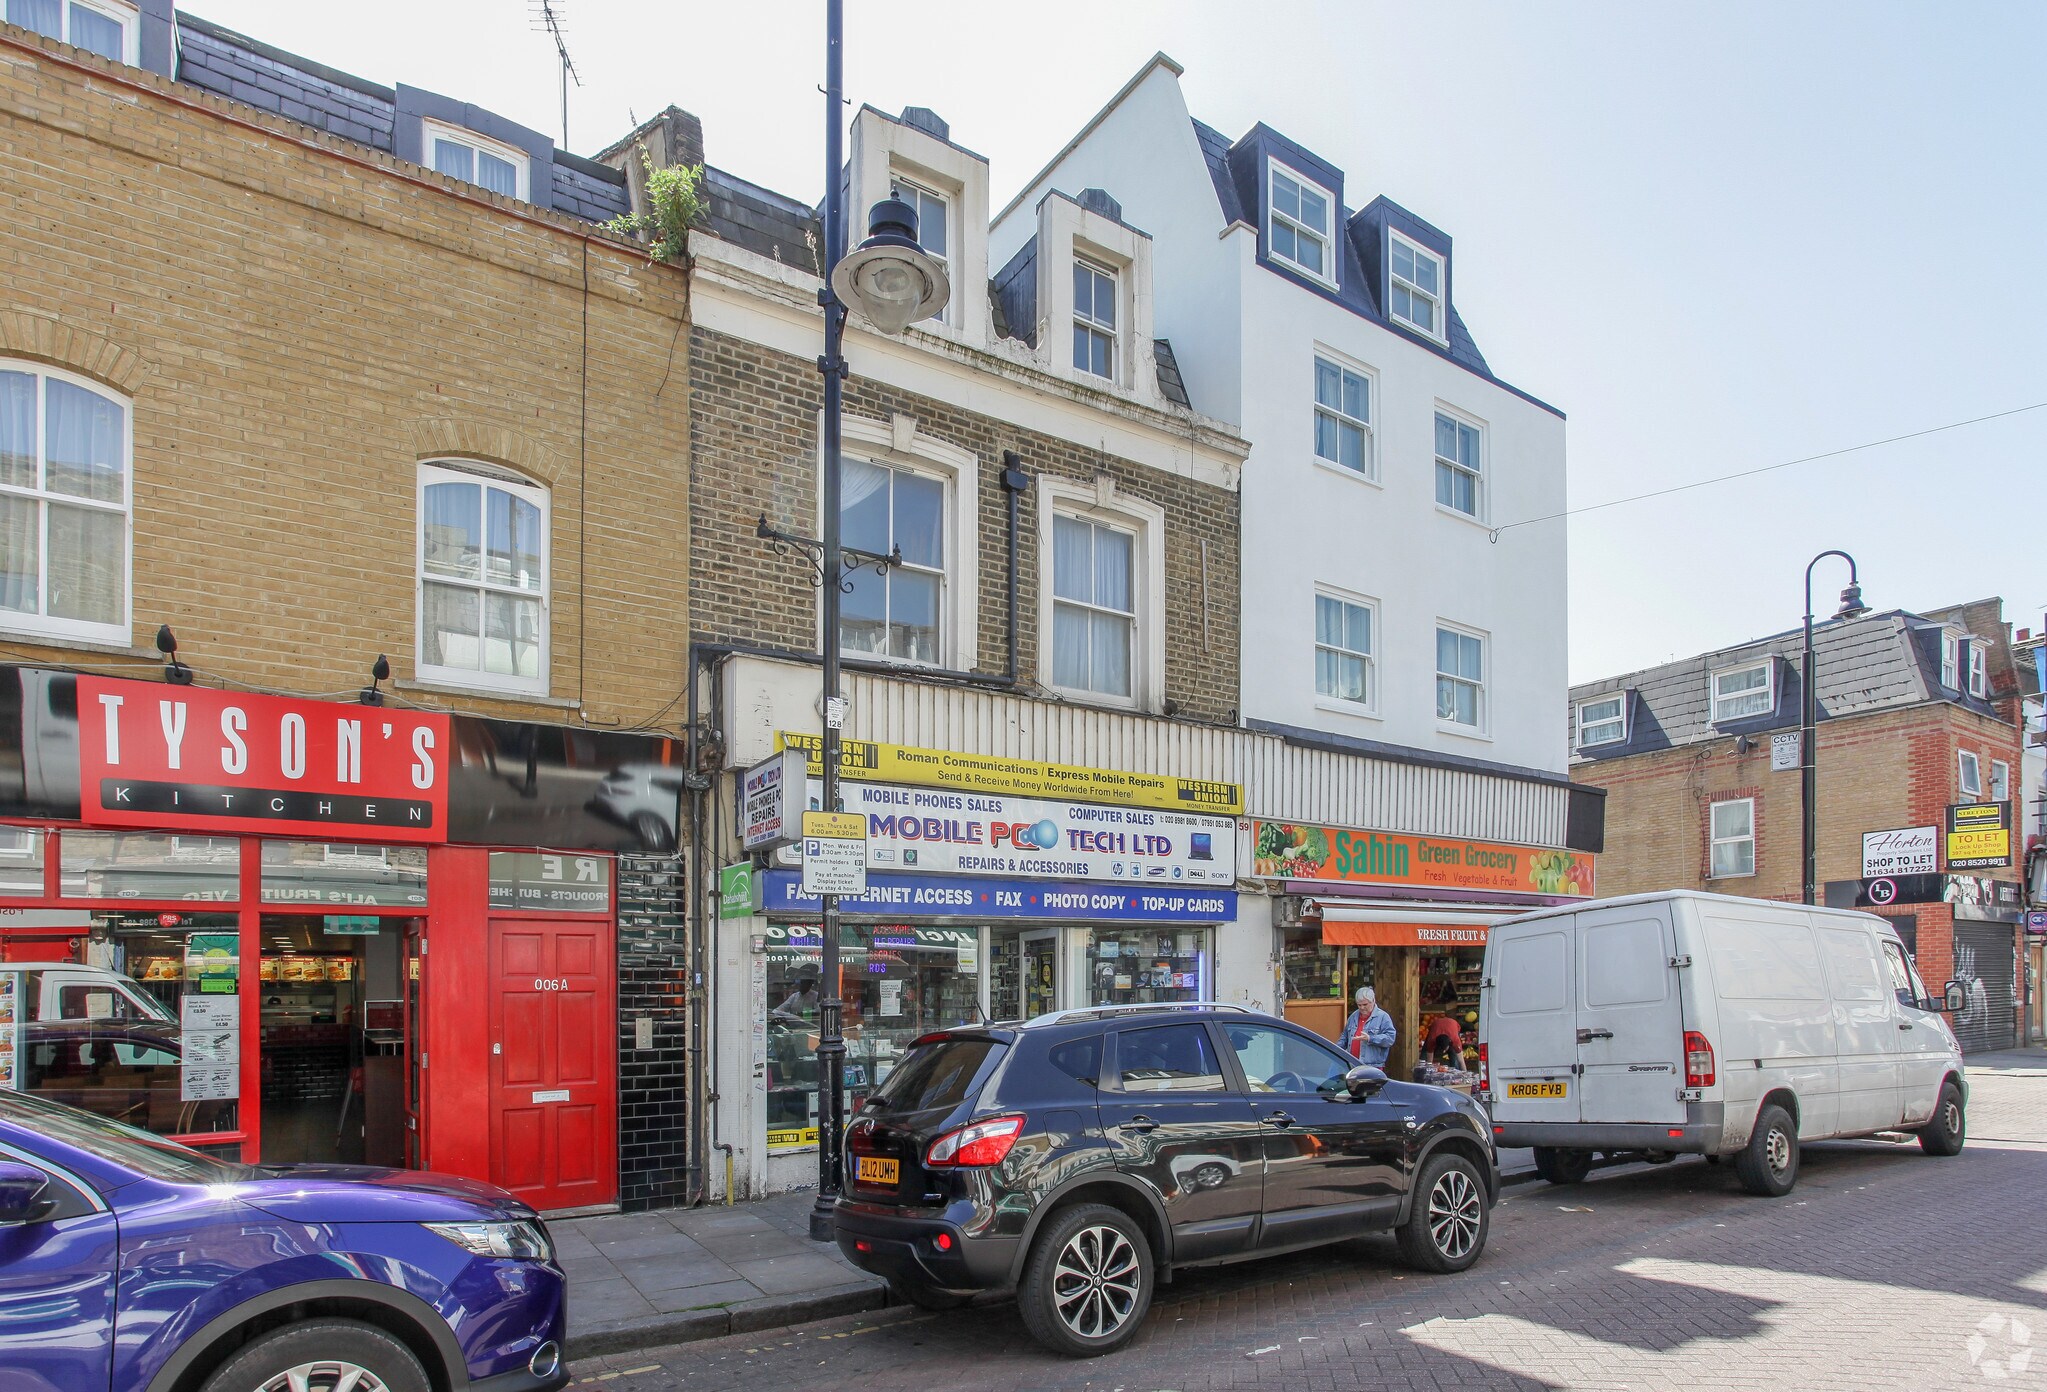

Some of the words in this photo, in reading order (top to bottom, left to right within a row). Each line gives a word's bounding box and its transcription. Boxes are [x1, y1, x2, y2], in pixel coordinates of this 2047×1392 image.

[828, 720, 842, 728] 128
[98, 694, 435, 789] TYSON'S
[787, 735, 864, 755] WESRN
[1773, 734, 1798, 744] CCTV
[812, 750, 864, 767] UON
[839, 766, 867, 777] ANSFER
[897, 749, 939, 765] Roman
[943, 755, 1038, 776] Communications
[1047, 767, 1090, 782] Express
[1092, 772, 1126, 785] Mobile
[1128, 777, 1165, 789] Repairs
[938, 770, 962, 782] Send
[964, 773, 972, 782] &
[974, 775, 1010, 786] Receive
[1012, 779, 1042, 792] Money
[1043, 781, 1087, 795] Worldwide
[1090, 787, 1110, 797] From
[1112, 789, 1134, 799] Here!
[1178, 780, 1228, 795] WESTERN
[115, 787, 422, 821] KITCHEN
[863, 788, 909, 805] MOBILE
[914, 793, 963, 810] PHONES
[967, 798, 1002, 813] SALES
[1193, 791, 1228, 804] UNION
[751, 805, 776, 825] REPAIRS
[1186, 802, 1205, 810] MONEY
[1205, 804, 1230, 812] TRANSFER
[1069, 807, 1123, 823] COMPUTER
[1125, 810, 1155, 826] SALES
[1165, 816, 1174, 824] 020
[1175, 816, 1185, 825] 8981
[1186, 817, 1197, 826] 8600
[1202, 819, 1215, 827] 07951
[1215, 819, 1224, 828] 053
[746, 823, 765, 838] INTERNET
[765, 817, 781, 832] ACCESS
[869, 813, 983, 845] MOBILE
[1066, 828, 1126, 855] TECH
[1133, 834, 1173, 857] LTD
[1239, 822, 1249, 831] 59
[1866, 833, 1933, 851] Horton
[1957, 835, 1973, 843] TO
[1977, 833, 1999, 842] LET
[808, 841, 818, 855] P
[959, 855, 1005, 871] REPAIRS
[1008, 859, 1016, 871] &
[1019, 859, 1089, 875] ACCESSORIES
[1418, 840, 1460, 866] Green
[1465, 844, 1518, 874] Grocery
[1866, 857, 1893, 868] SHOP
[1897, 856, 1910, 865] TO
[1914, 854, 1933, 864] LET
[1988, 857, 2006, 866] 9911
[1424, 869, 1447, 882] Fresh
[1453, 872, 1490, 887] Vegetable
[1492, 875, 1498, 886] &
[1500, 876, 1518, 887] Fruit
[1866, 868, 1894, 876] 01634
[1897, 865, 1933, 874] 817222
[914, 888, 973, 905] ACCESS
[996, 891, 1022, 907] FAX
[1043, 892, 1089, 909] PHOTO
[1091, 894, 1126, 910] COPY
[1142, 896, 1185, 912] TOP-UP
[1187, 898, 1225, 913] CARDS
[1417, 929, 1449, 941] FRESH
[1450, 929, 1478, 941] FRUIT
[1479, 930, 1486, 941] &
[534, 979, 568, 991] 006A
[1511, 1084, 1538, 1096] KR06
[1541, 1084, 1562, 1095] FVB
[879, 1161, 896, 1180] UMH
